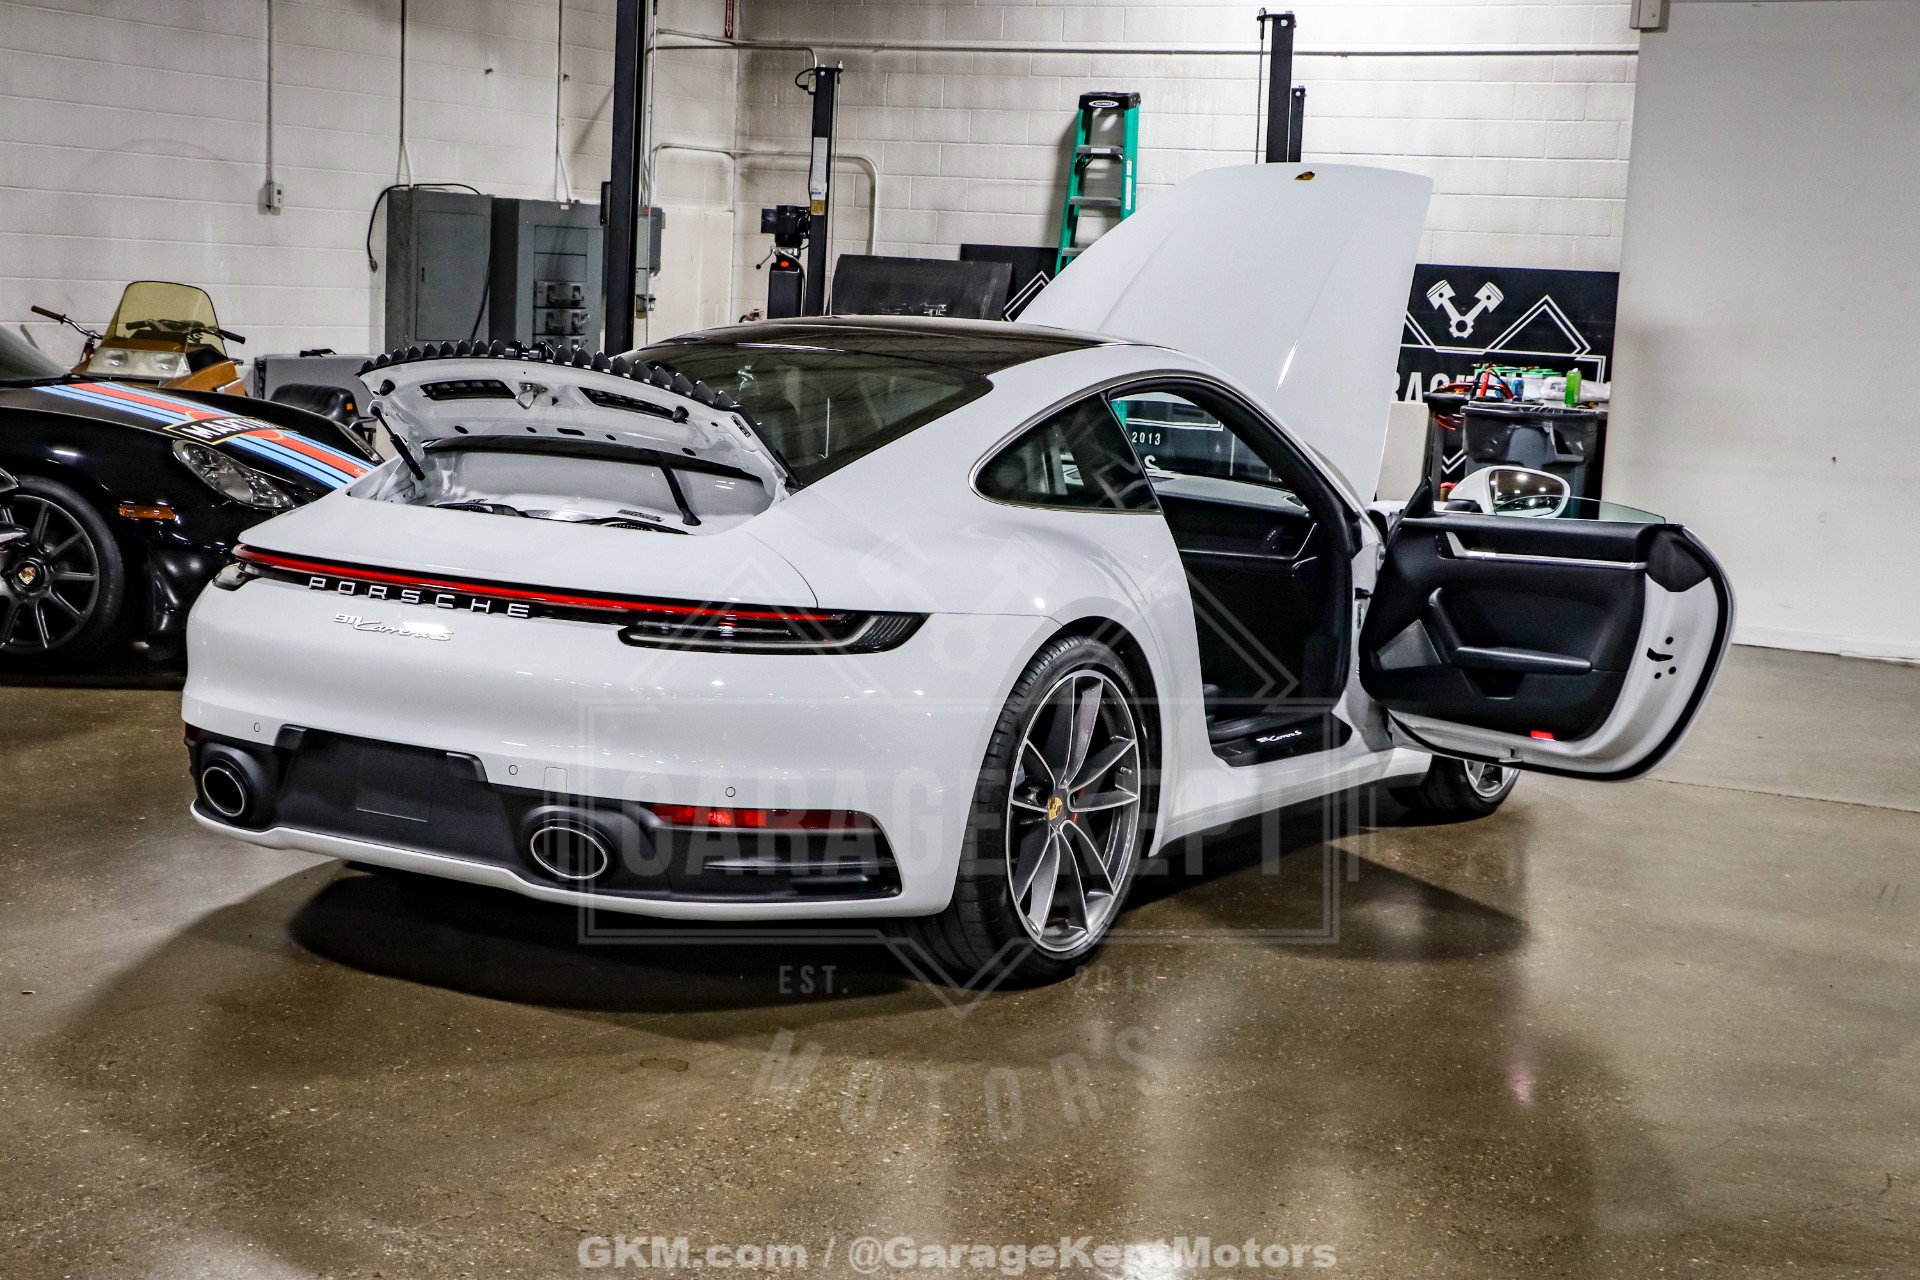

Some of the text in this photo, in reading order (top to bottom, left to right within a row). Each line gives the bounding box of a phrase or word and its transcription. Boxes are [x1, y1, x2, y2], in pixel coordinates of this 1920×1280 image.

[1131, 431, 1161, 446] 2013
[308, 576, 530, 619] PORSCHE
[333, 613, 363, 625] 911
